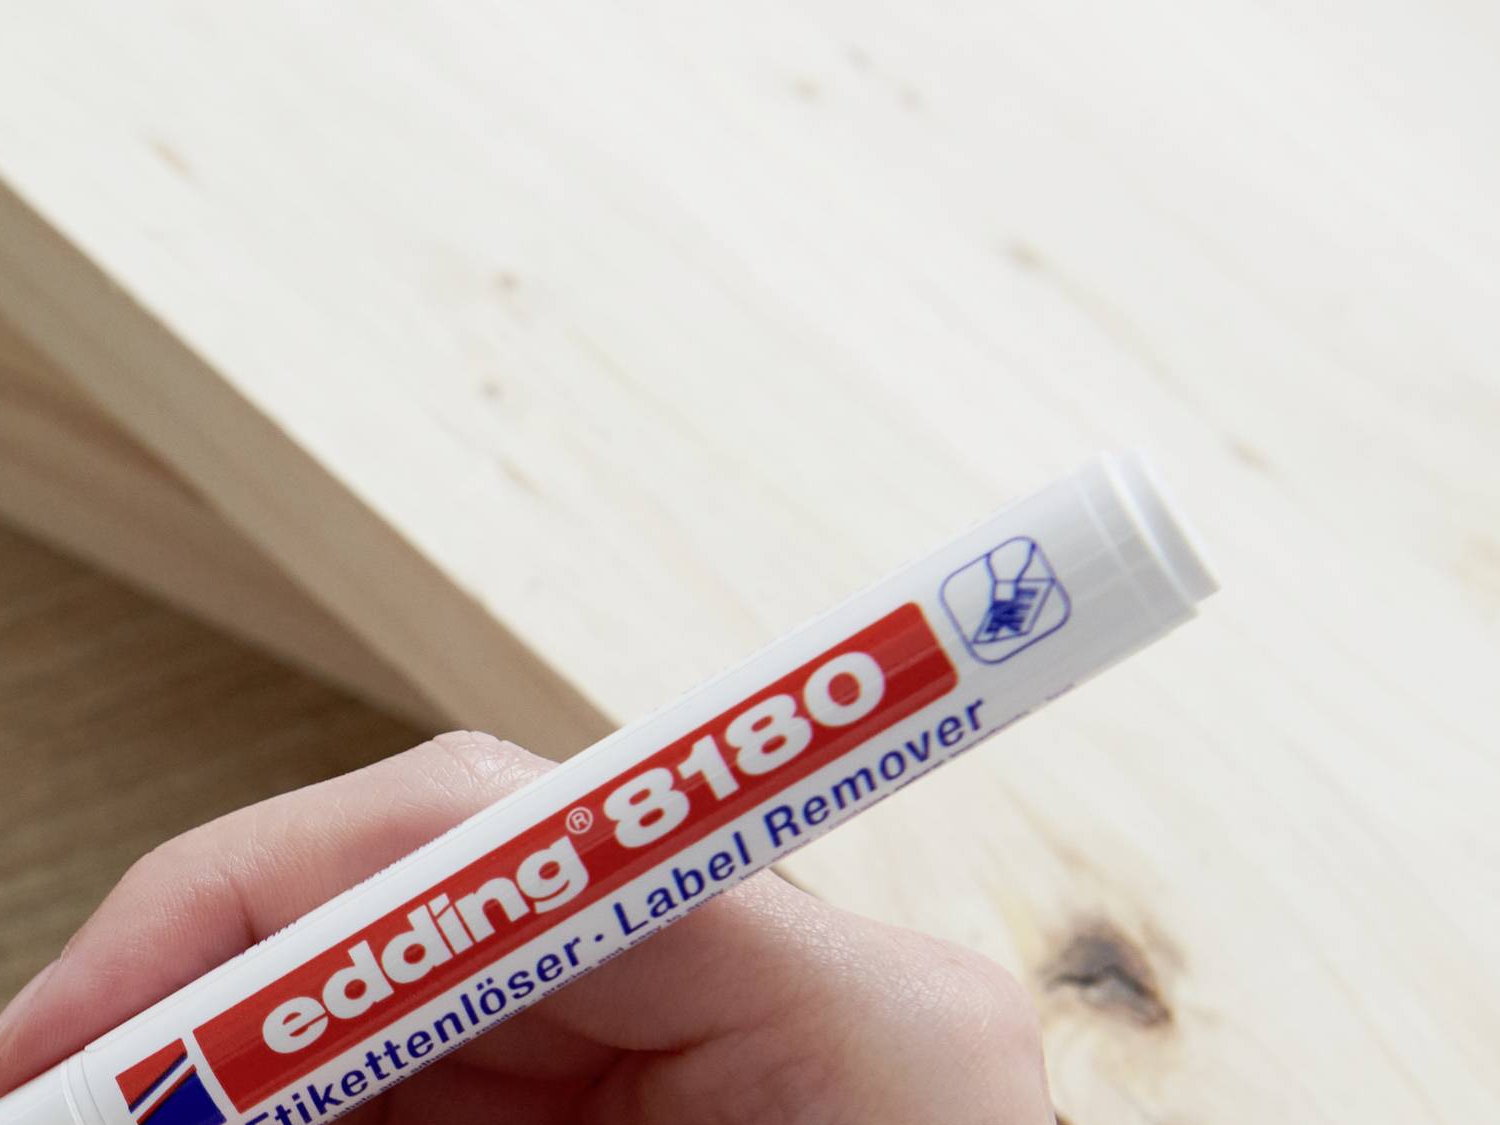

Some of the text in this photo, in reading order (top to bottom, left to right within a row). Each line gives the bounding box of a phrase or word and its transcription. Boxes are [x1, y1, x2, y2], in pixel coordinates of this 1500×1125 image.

[604, 652, 884, 847] 8180
[613, 832, 748, 935] Label
[763, 700, 980, 847] Remover
